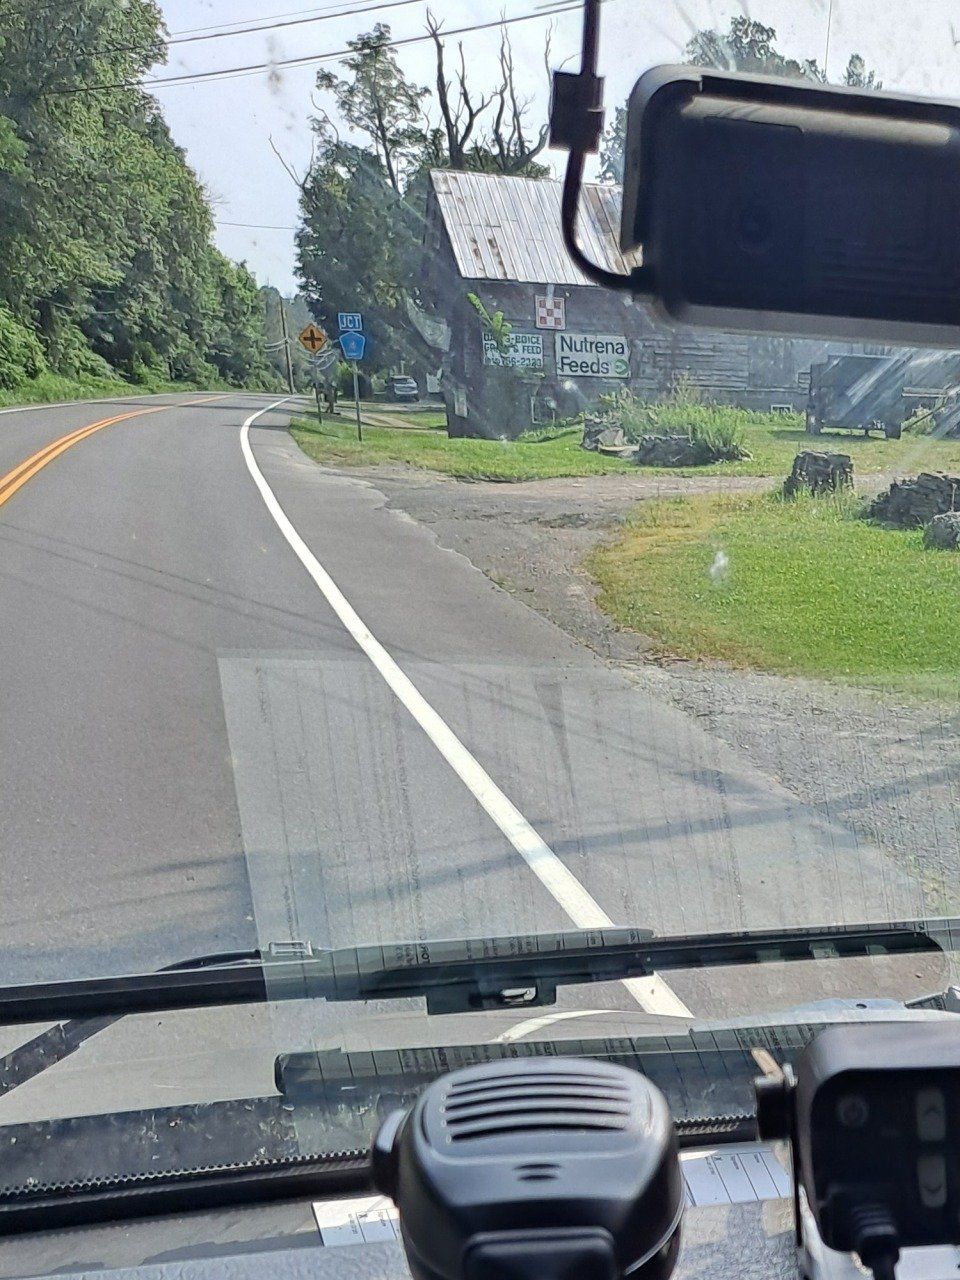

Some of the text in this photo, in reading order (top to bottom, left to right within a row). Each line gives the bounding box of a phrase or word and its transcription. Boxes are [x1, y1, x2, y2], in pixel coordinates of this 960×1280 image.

[341, 316, 360, 328] JCT
[522, 345, 542, 354] FEED
[560, 336, 625, 354] Nutrena
[561, 357, 610, 374] Feeds
